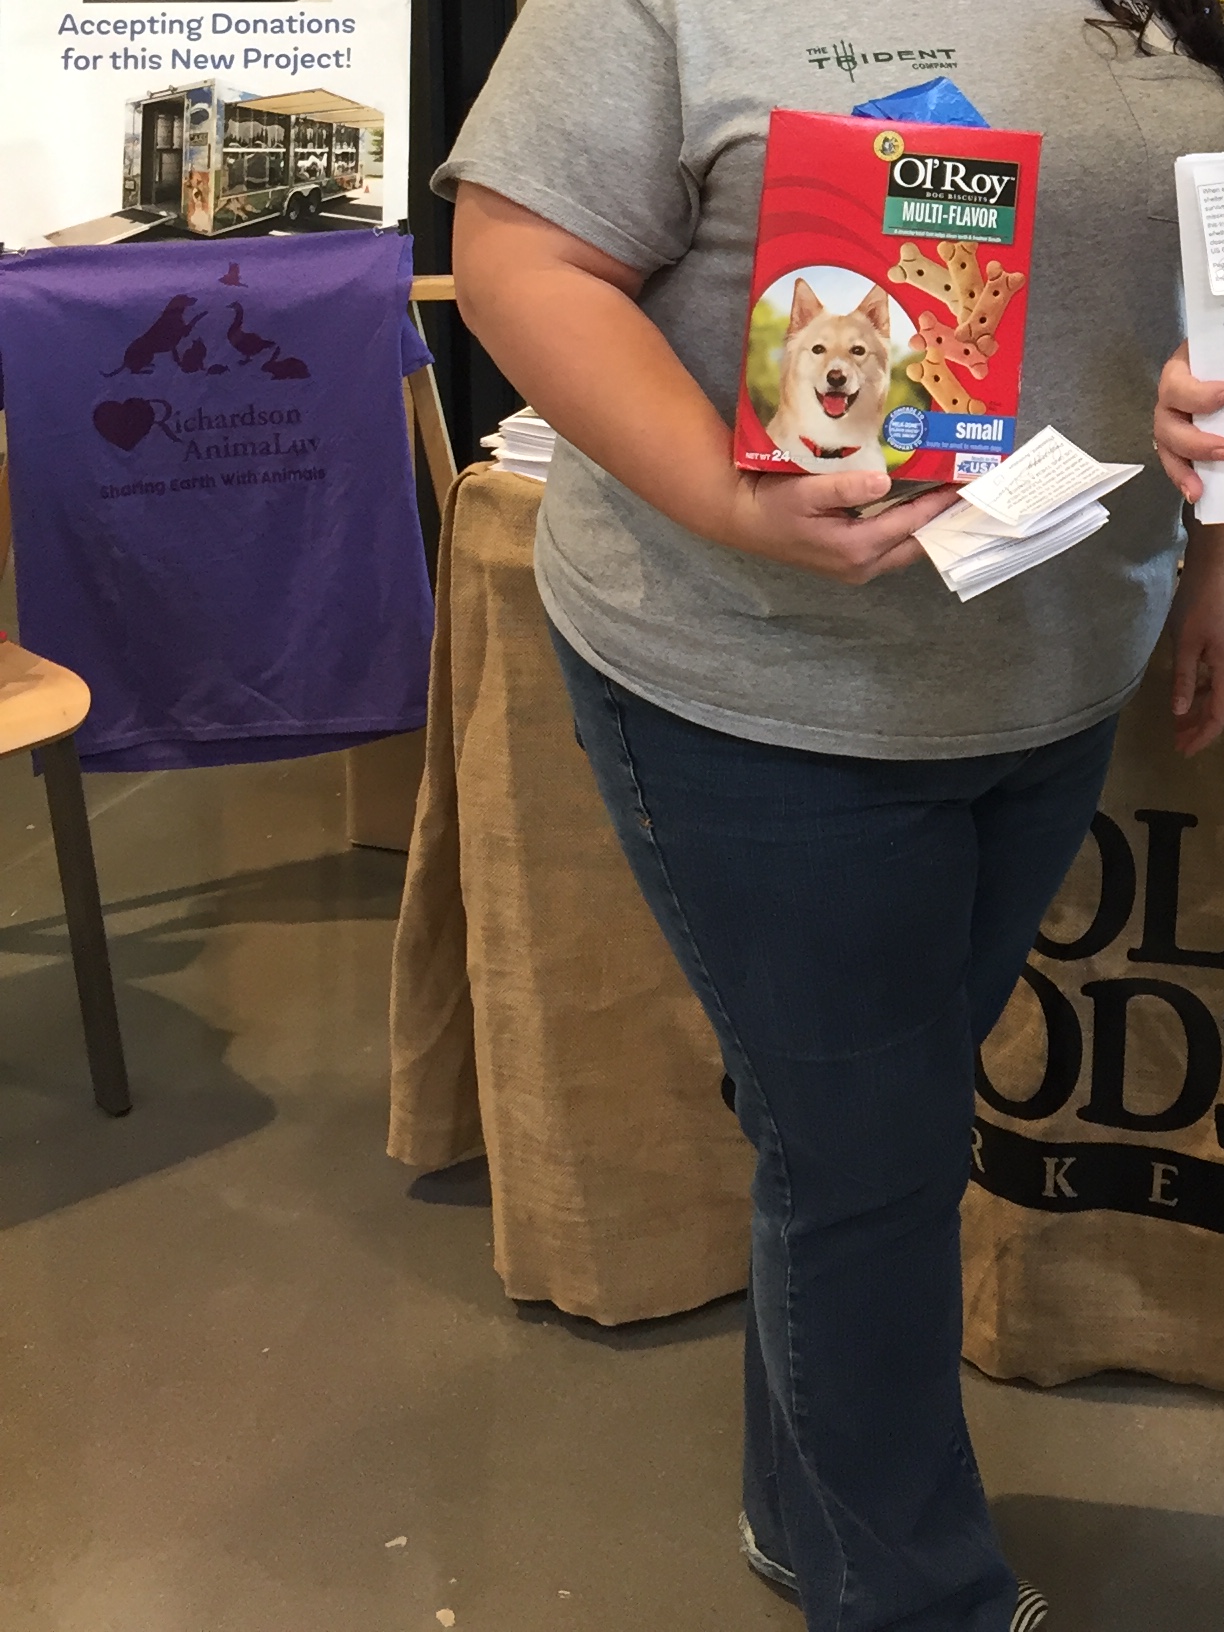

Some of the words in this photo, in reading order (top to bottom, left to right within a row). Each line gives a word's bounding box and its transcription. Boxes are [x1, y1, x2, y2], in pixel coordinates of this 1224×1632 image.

[57, 11, 204, 41] Accepting
[211, 11, 356, 34] Donations
[61, 47, 103, 70] for
[109, 47, 162, 71] this
[171, 48, 235, 70] New
[243, 46, 352, 76] Project!
[806, 47, 828, 55] THE
[808, 44, 956, 74] TRIDENT
[911, 62, 958, 70] COMPANY
[925, 191, 945, 199] DOG
[947, 194, 989, 203] BISCUITS
[902, 201, 998, 229] MULTI-FLAVOR
[148, 399, 302, 443] Richardson
[956, 419, 1004, 441] small
[183, 432, 321, 462] AnimaLuv
[772, 450, 790, 462] 24
[970, 461, 998, 473] USA
[101, 481, 165, 500] Sharing
[169, 474, 216, 492] Earth
[220, 470, 258, 487] With
[261, 466, 327, 485] Animals
